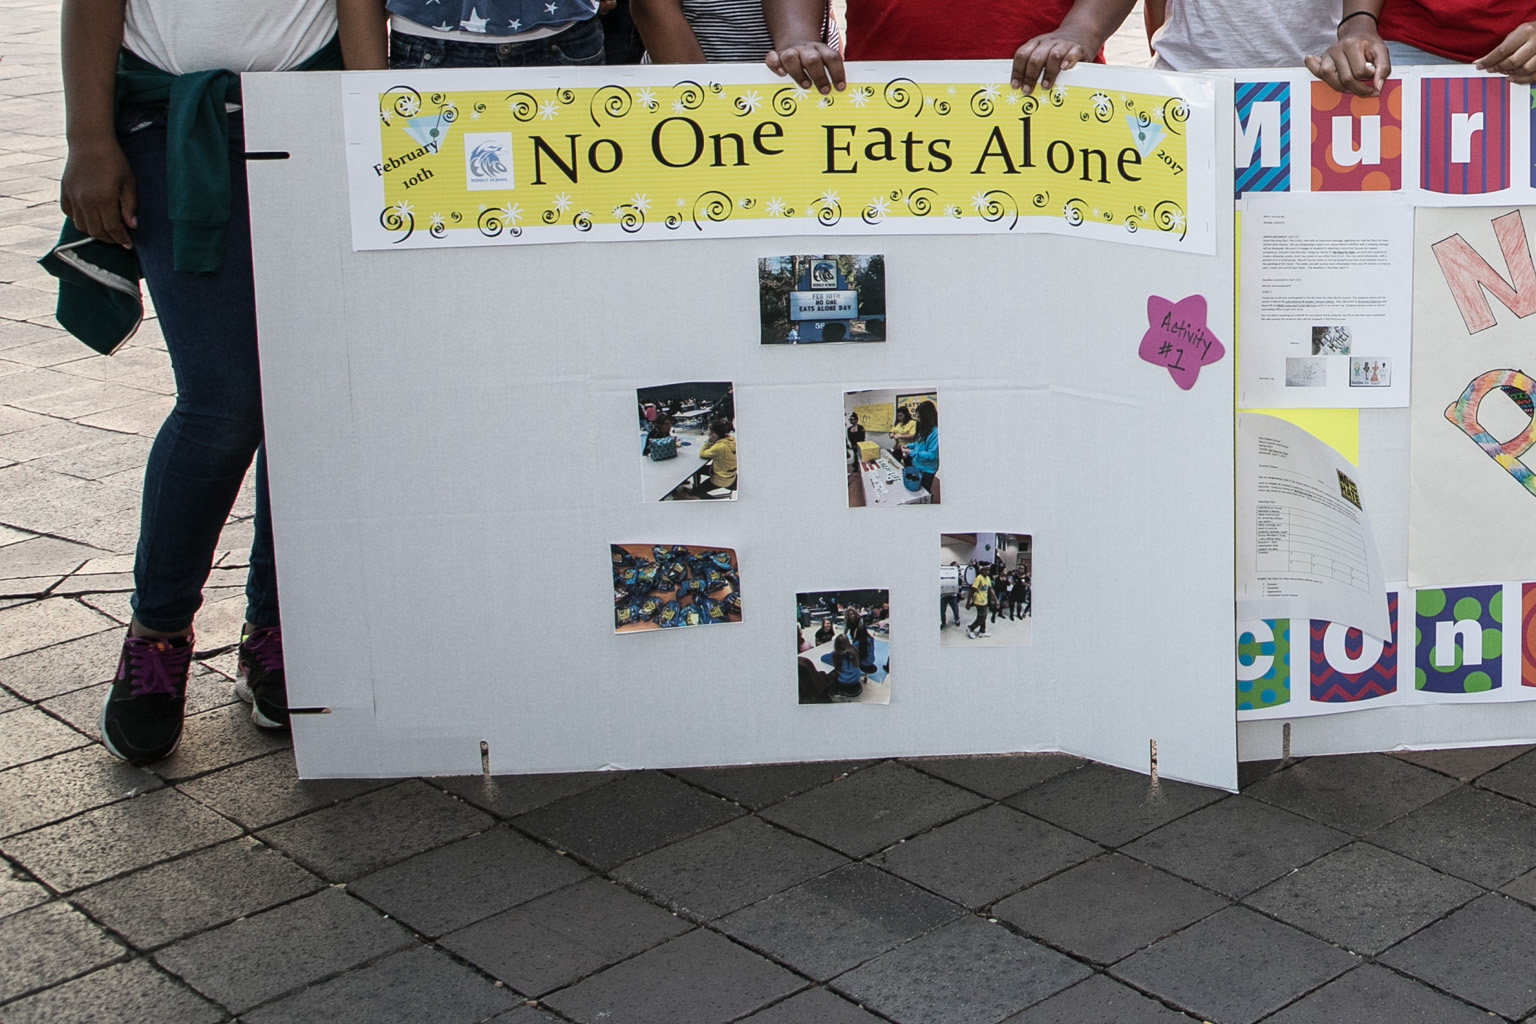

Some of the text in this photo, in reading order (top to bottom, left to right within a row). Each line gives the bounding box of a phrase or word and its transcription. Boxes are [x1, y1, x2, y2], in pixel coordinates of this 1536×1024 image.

[373, 139, 440, 177] February
[528, 116, 1143, 186] No One Eats Alone
[1155, 148, 1185, 177] 2017
[402, 166, 435, 190] 10th
[1161, 311, 1213, 361] Activity
